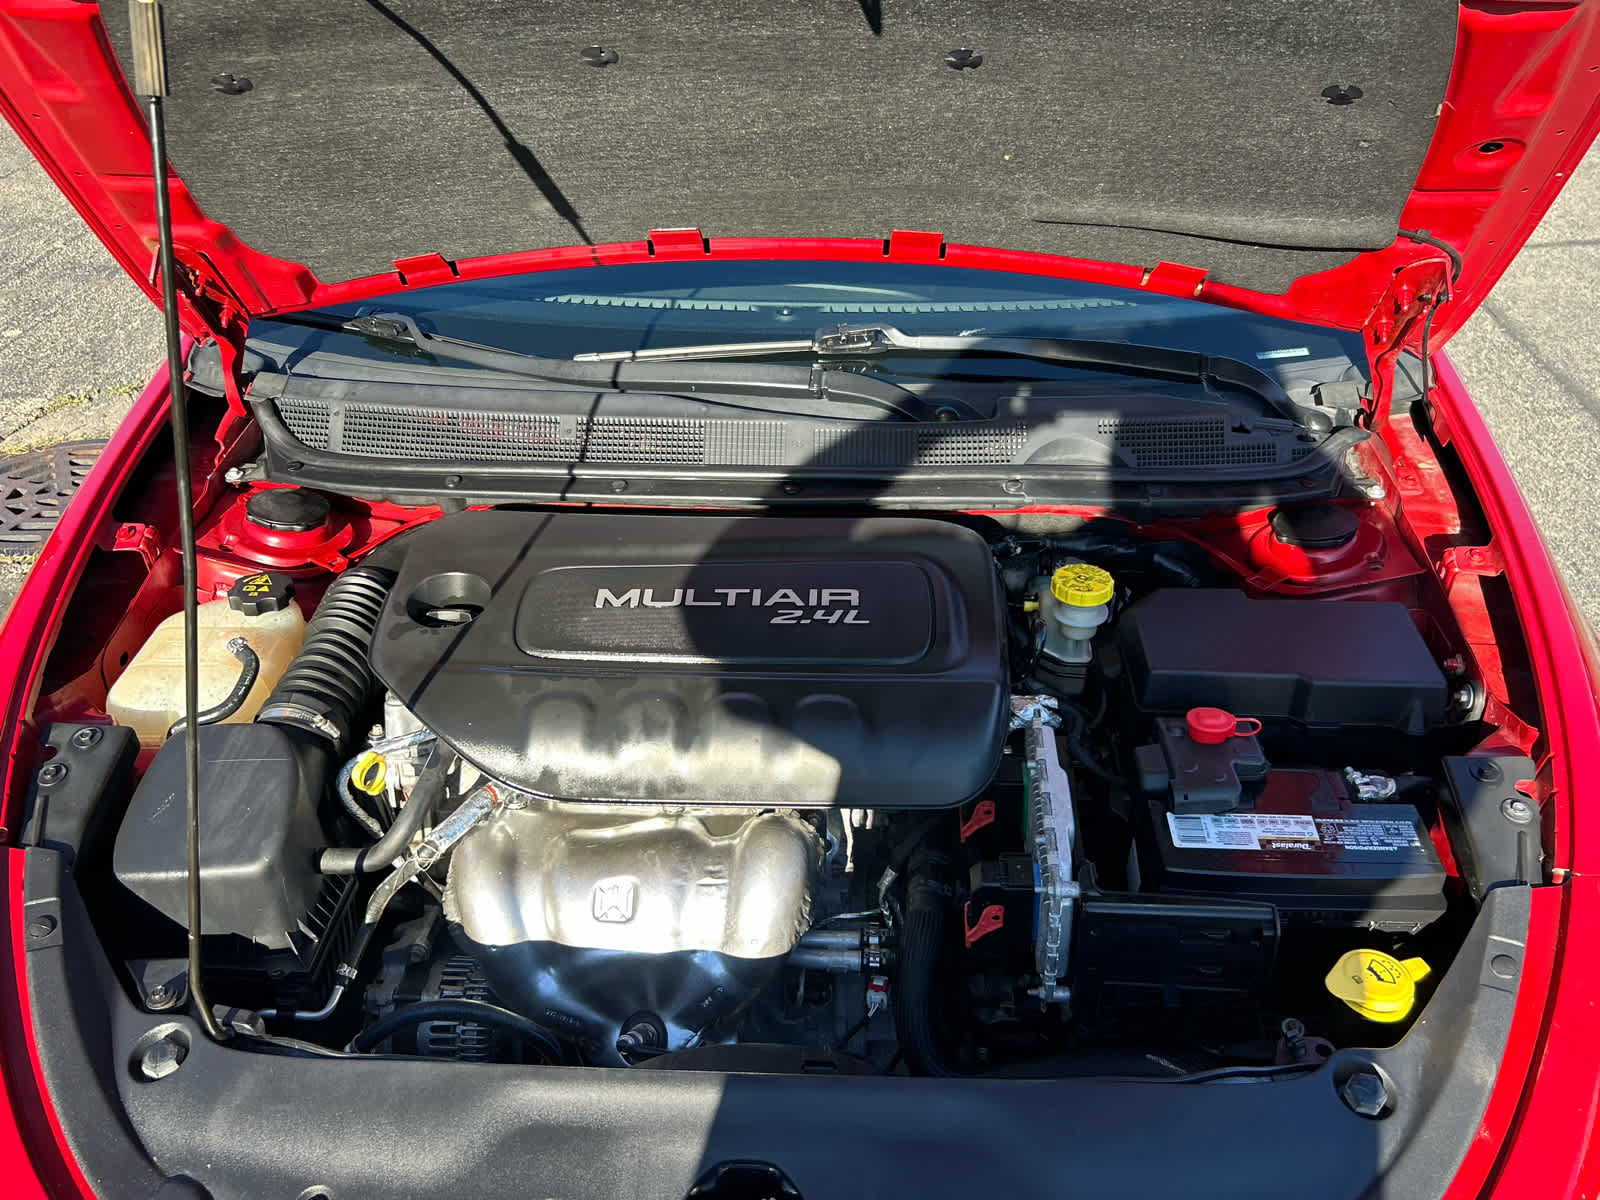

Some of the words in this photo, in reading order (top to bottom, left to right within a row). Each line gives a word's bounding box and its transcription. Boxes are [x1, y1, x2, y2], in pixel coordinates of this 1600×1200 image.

[595, 588, 860, 608] MULTIAIR
[769, 609, 870, 624] 2.4L
[1272, 842, 1312, 850] Duralast
